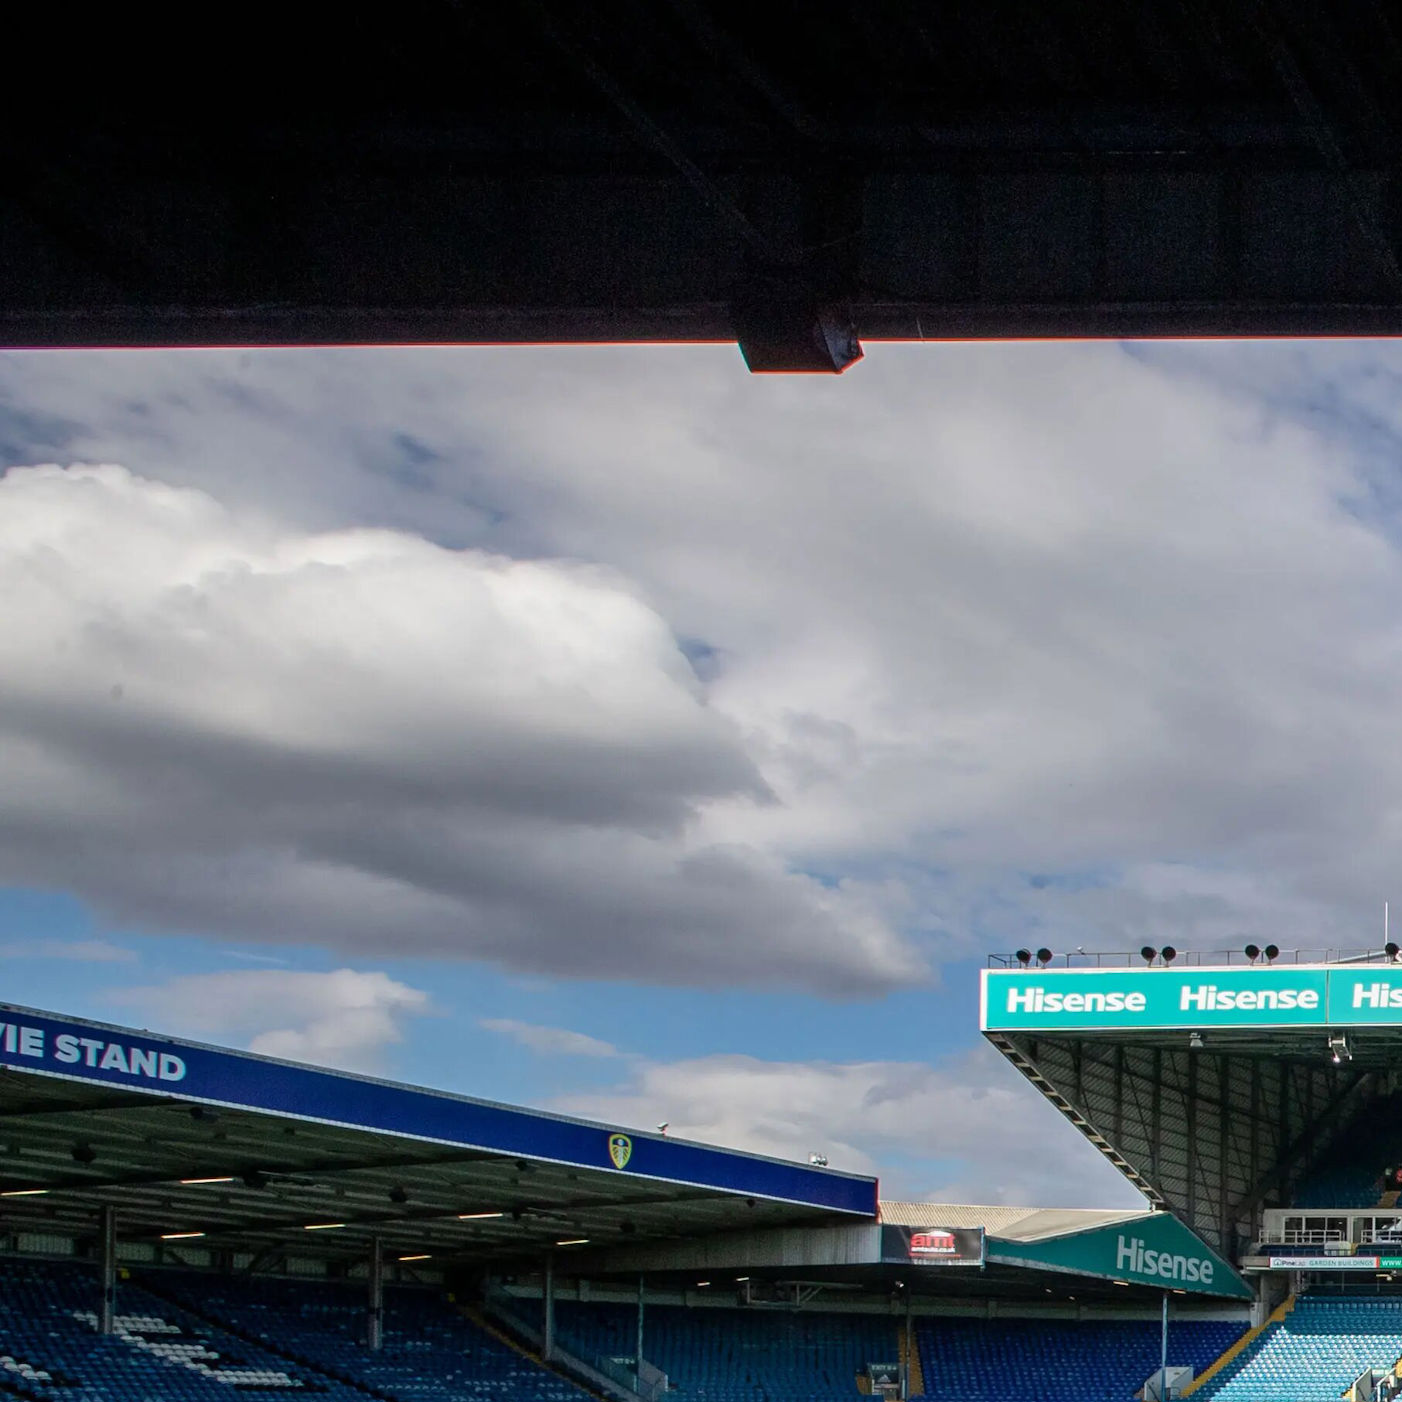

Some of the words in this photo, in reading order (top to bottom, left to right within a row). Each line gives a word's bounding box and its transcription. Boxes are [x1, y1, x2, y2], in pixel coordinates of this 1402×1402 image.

[1007, 987, 1146, 1013] Hisense
[1180, 986, 1319, 1011] Hisense
[54, 1033, 187, 1082] STAND
[1116, 1235, 1214, 1285] Hisense
[1309, 1259, 1336, 1267] GARDEN
[1338, 1259, 1374, 1267] BUILDINGS
